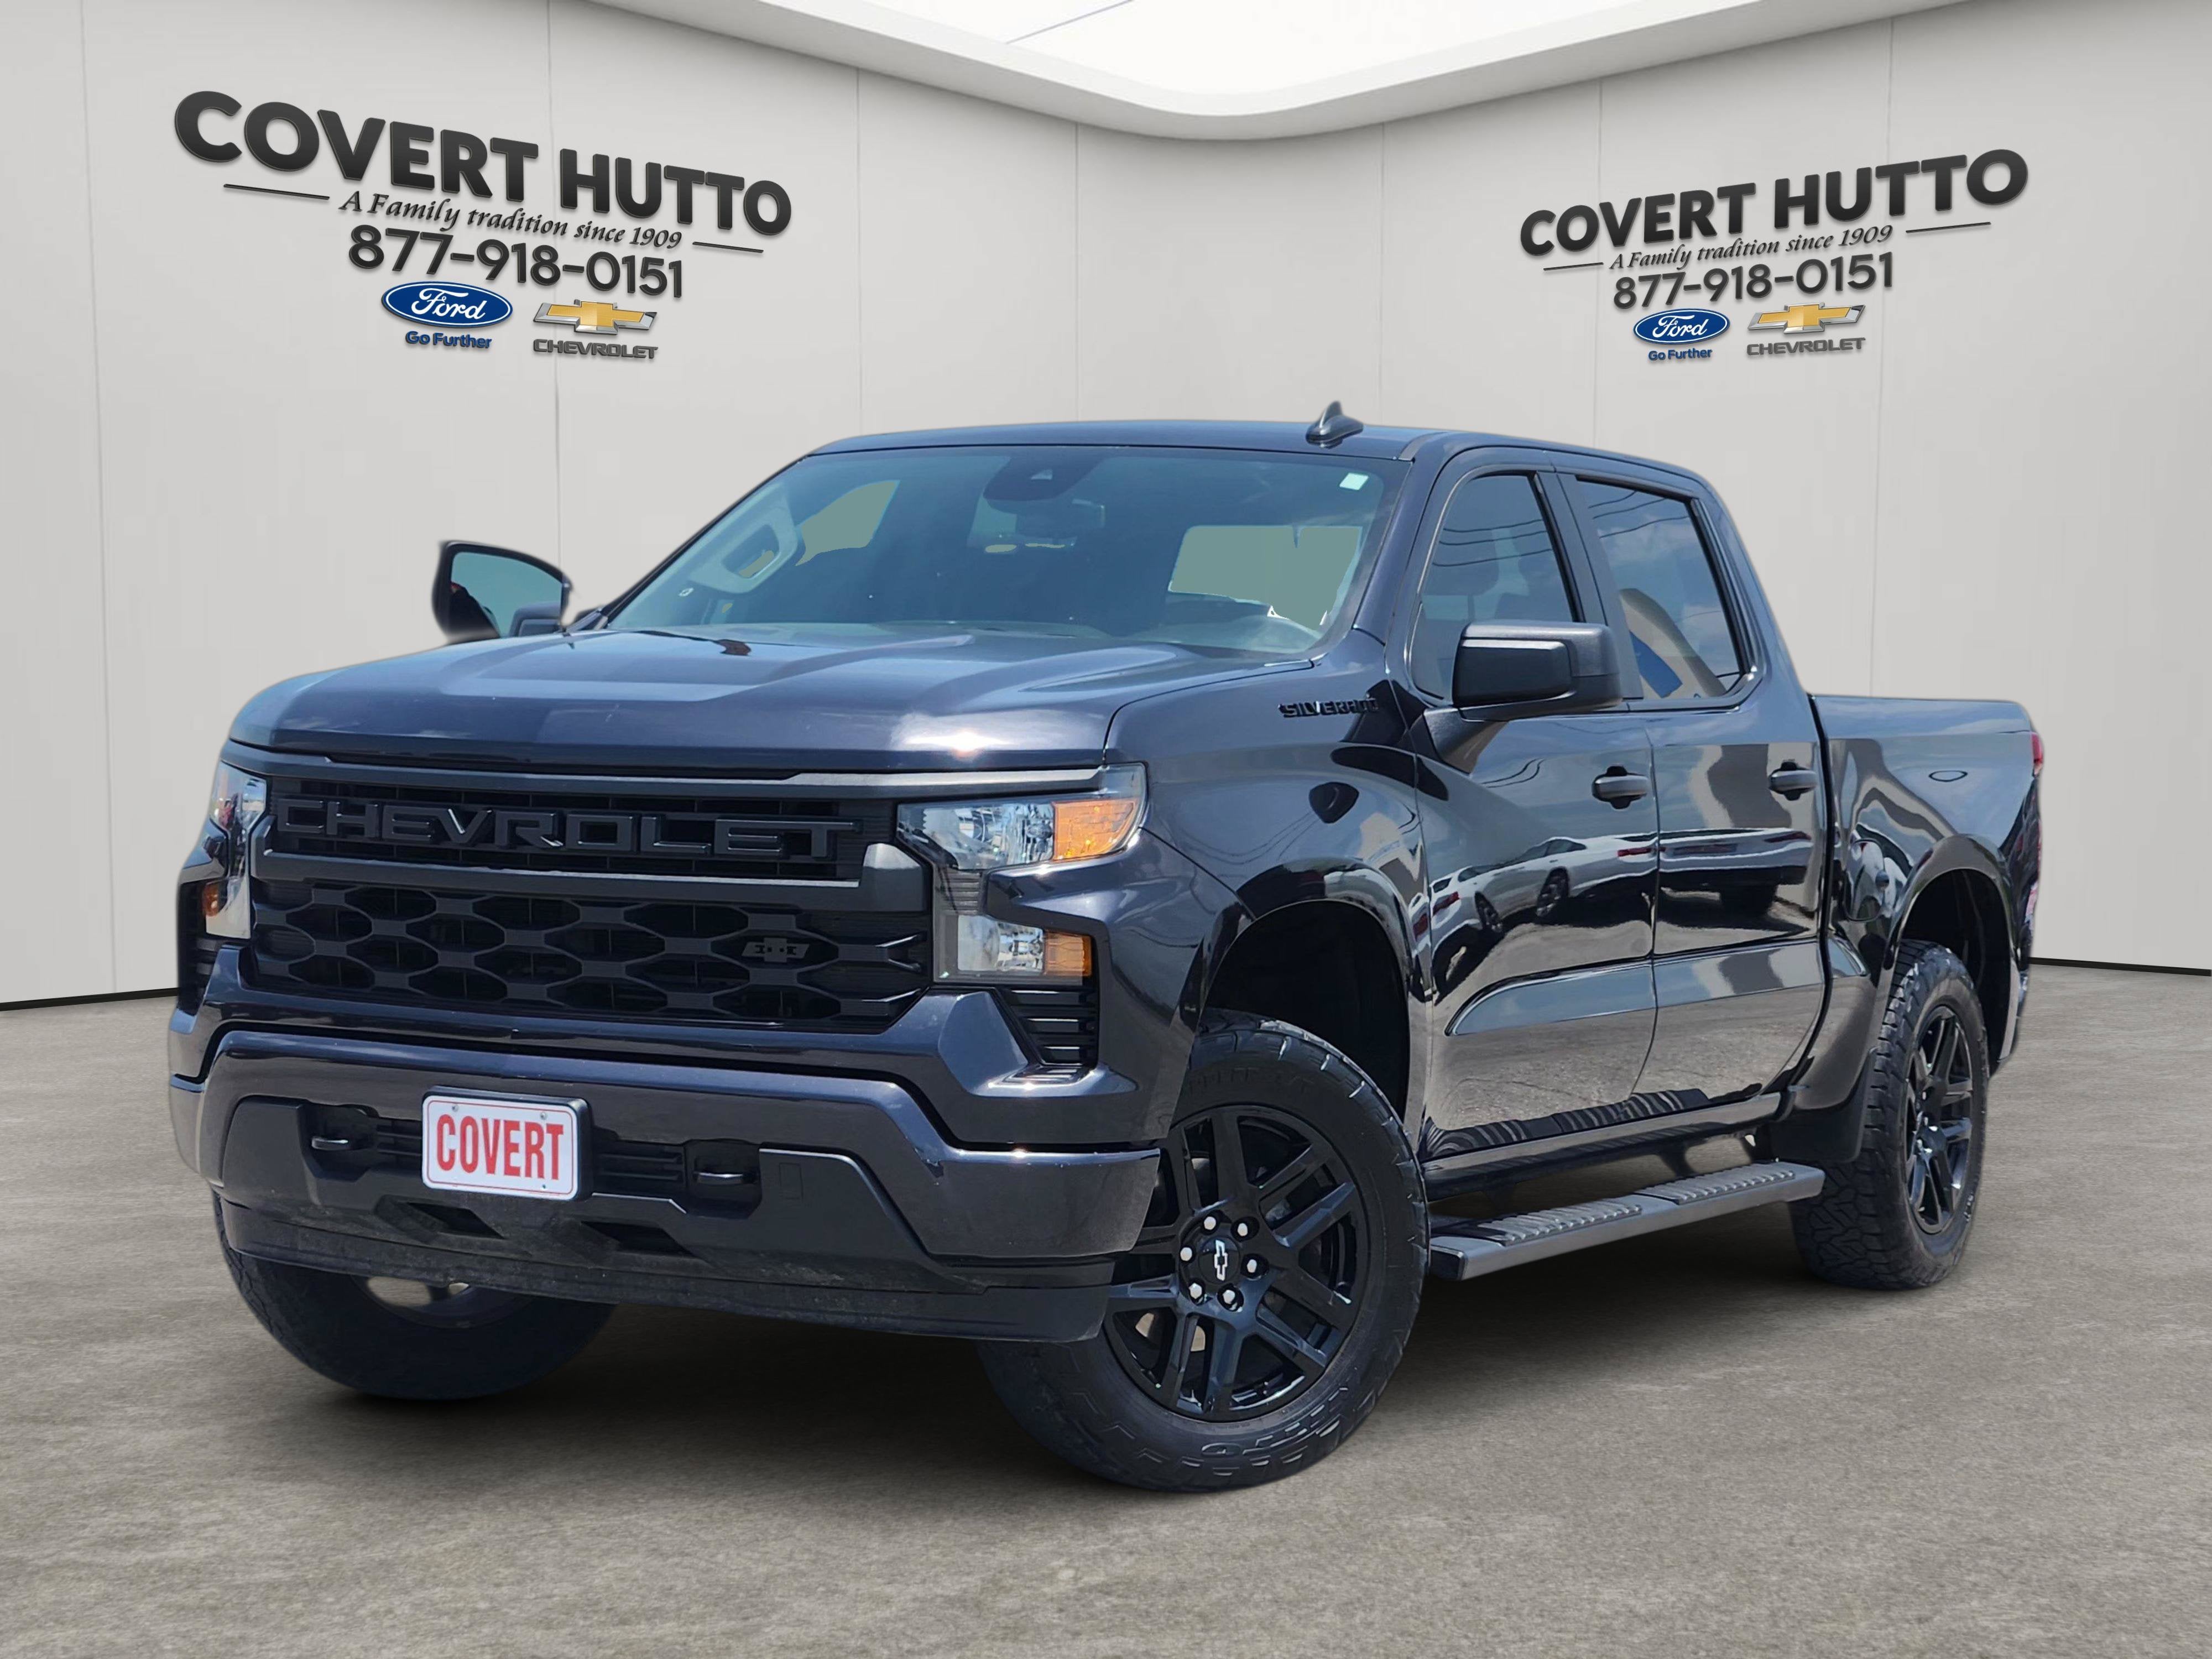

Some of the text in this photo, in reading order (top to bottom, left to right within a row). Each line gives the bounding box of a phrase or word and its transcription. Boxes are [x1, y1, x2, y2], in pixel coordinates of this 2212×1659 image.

[174, 91, 792, 236] COVERT HUTTO
[338, 191, 682, 249] A Family tradition since 1909
[1520, 149, 2028, 257] COVERT HUTTO
[348, 224, 682, 298] 877-918-0151
[1609, 224, 1893, 270] A Family tradition since 1909
[411, 288, 488, 320] Ford
[1613, 251, 1893, 310] 877-918-0151
[405, 331, 492, 348] Go Further
[533, 338, 659, 359] CHEVROLET
[1652, 315, 1710, 337] Ford
[1746, 337, 1866, 356] CHEVROLET
[1648, 347, 1713, 361] Go Further
[275, 797, 864, 860] CHEVROLET
[436, 1114, 564, 1180] COVERT
